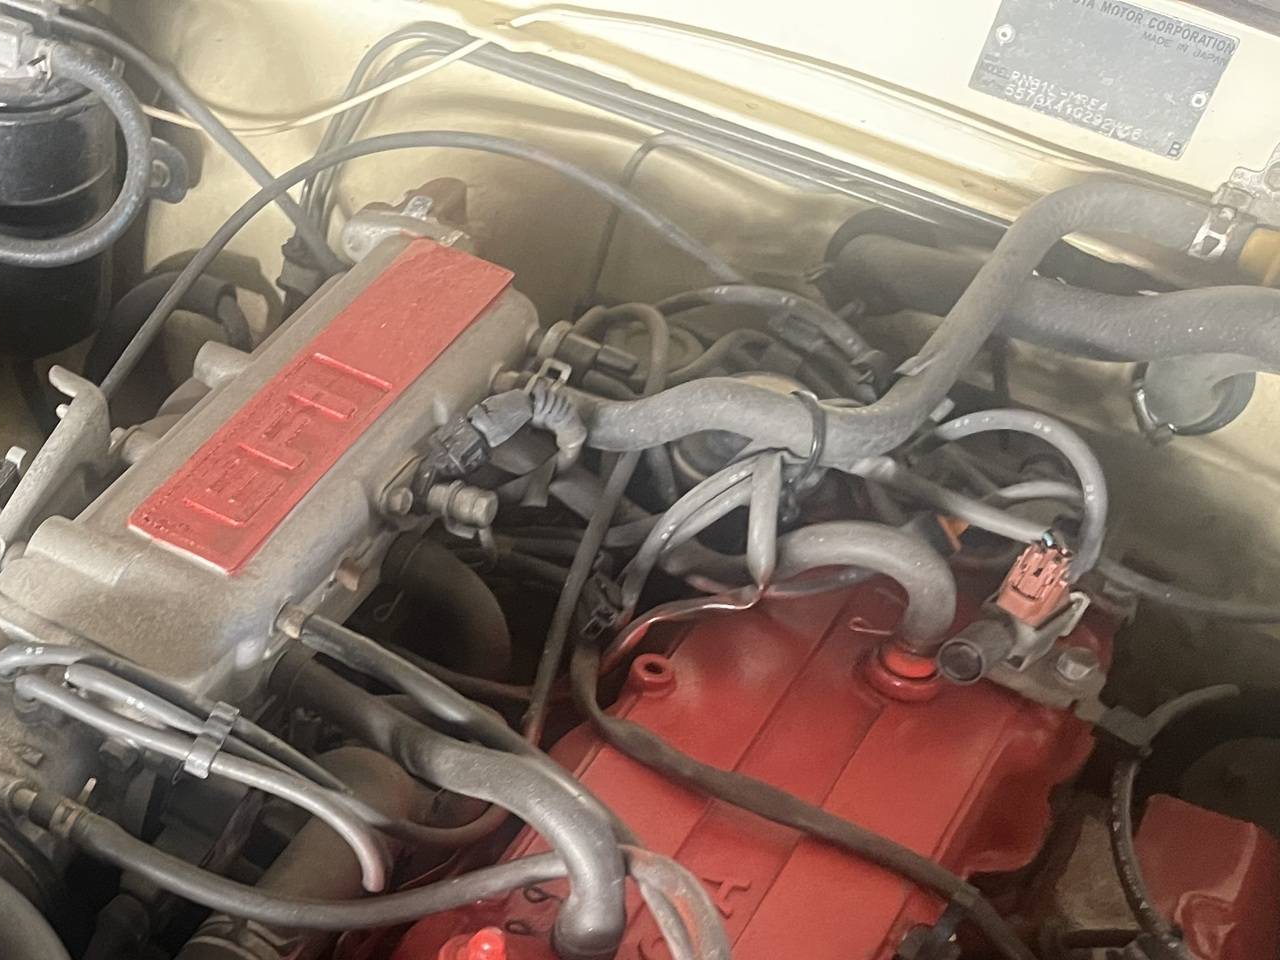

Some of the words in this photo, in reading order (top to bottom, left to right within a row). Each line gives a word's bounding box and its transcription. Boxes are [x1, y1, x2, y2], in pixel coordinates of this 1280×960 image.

[1101, 1, 1144, 26] MOTOR
[1147, 16, 1237, 55] CORPORATION
[1142, 31, 1171, 49] MADE
[182, 388, 358, 528] EFI
